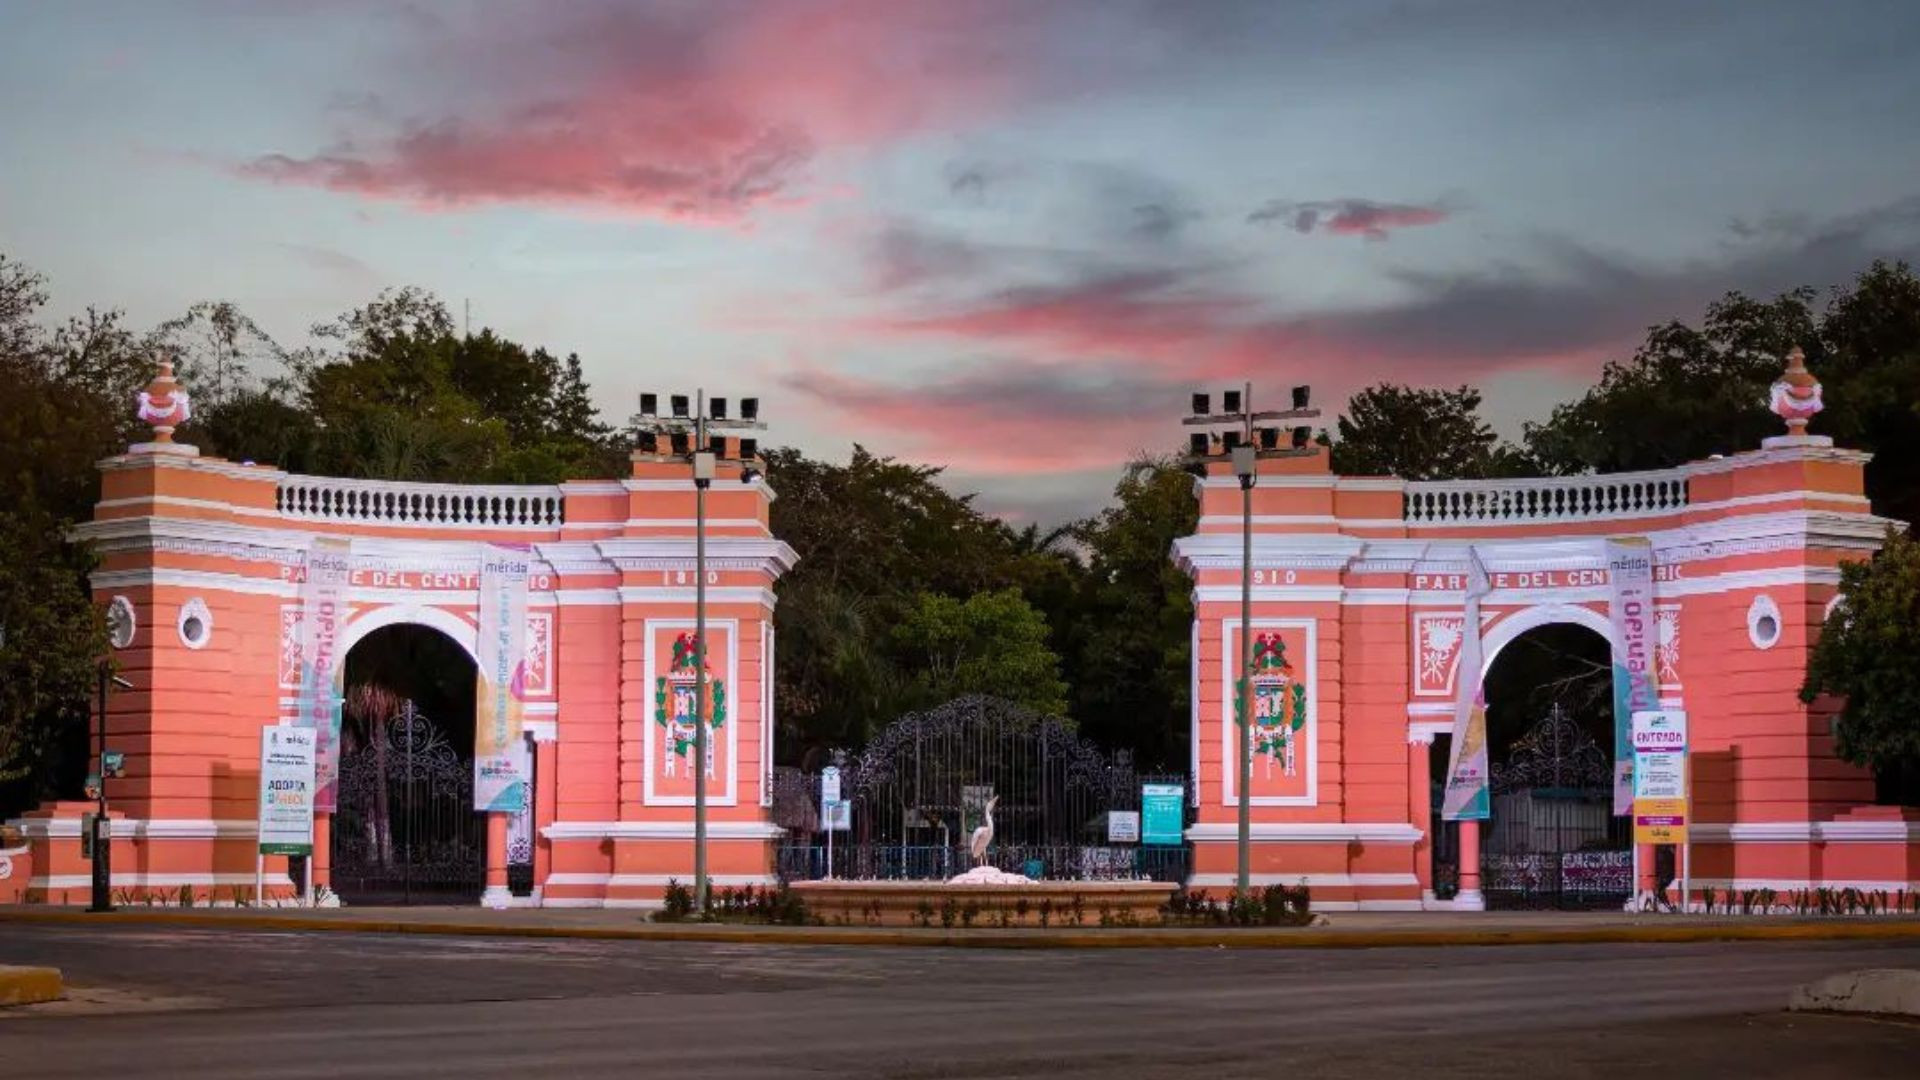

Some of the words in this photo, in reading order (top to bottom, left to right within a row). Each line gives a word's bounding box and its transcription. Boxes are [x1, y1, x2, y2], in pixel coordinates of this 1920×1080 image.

[485, 559, 527, 573] mérida
[1611, 556, 1648, 570] mérida
[282, 566, 363, 584] PAE
[373, 571, 412, 587] DEL
[421, 574, 549, 589] CENTIO
[1416, 574, 1508, 589] PARE
[1520, 571, 1557, 587] DEL
